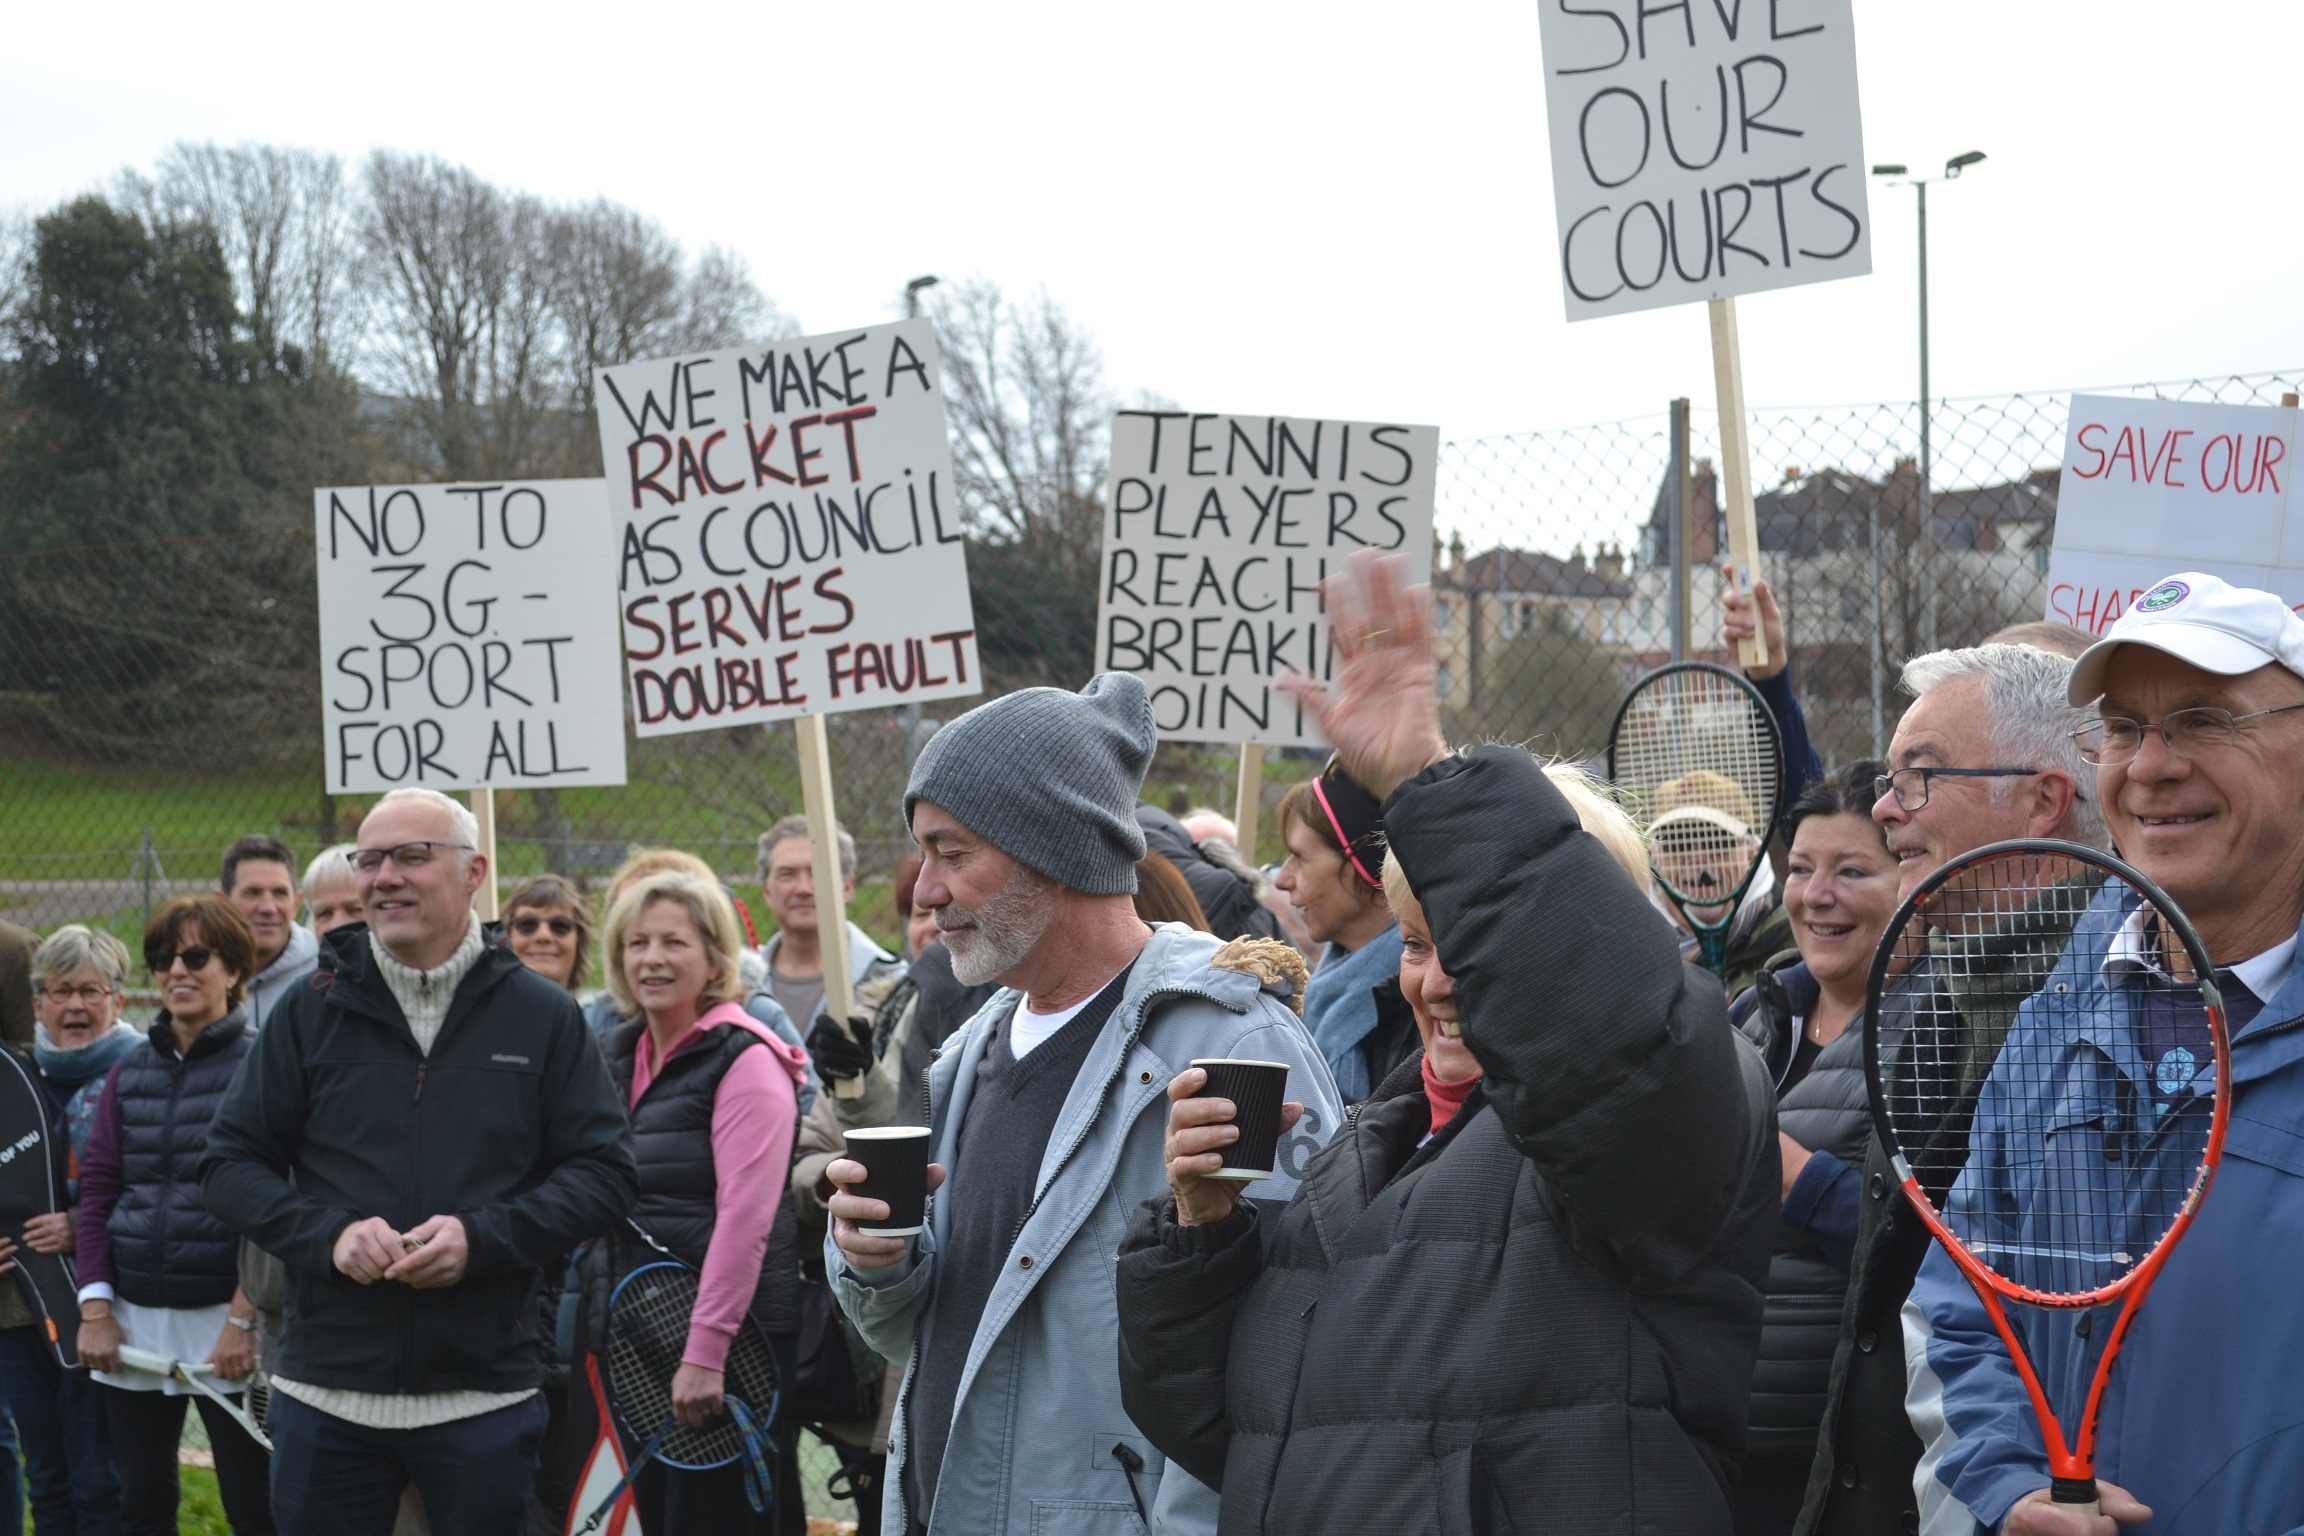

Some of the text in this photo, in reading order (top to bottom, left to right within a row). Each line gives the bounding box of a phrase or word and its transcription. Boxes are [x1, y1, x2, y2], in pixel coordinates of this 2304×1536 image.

[1579, 55, 1804, 188] OUR
[1564, 164, 1860, 302] COURTS
[603, 333, 931, 440] WE MAKE A
[627, 406, 877, 509] RACKET
[1117, 411, 1412, 486] TENNIS
[2072, 423, 2286, 494] SAVE OUR
[331, 485, 546, 559] NO TO
[1115, 477, 1409, 549] PLAYERS
[620, 514, 683, 591] AS
[1107, 549, 1326, 614] REACH
[625, 566, 854, 661] SERVES
[333, 636, 573, 712] SPORT
[634, 629, 975, 724] DOUBLE FAULT
[1151, 683, 1327, 737] OINT
[339, 719, 590, 787] FOR ALL
[0, 1129, 40, 1163] OF YOU
